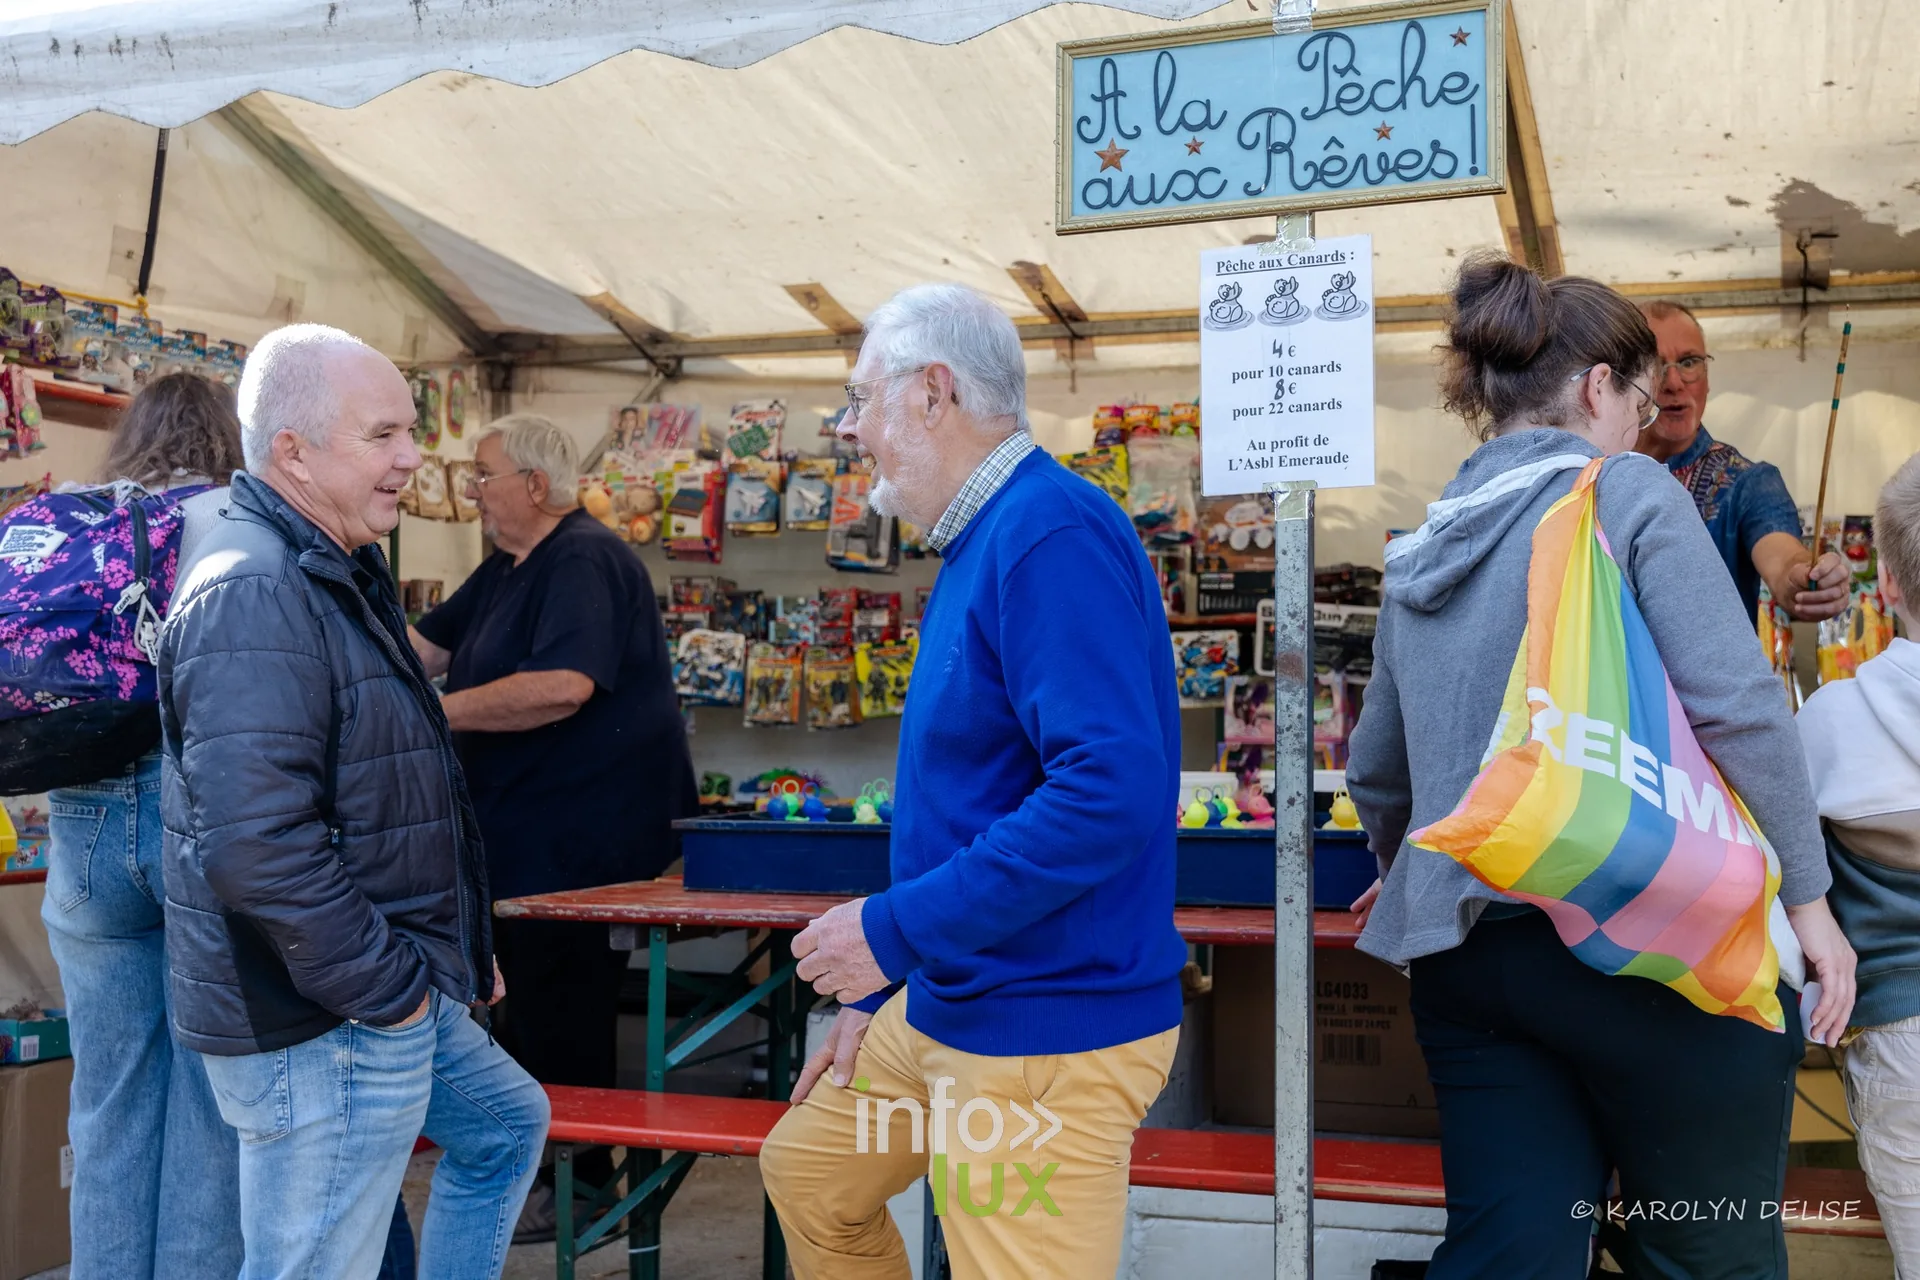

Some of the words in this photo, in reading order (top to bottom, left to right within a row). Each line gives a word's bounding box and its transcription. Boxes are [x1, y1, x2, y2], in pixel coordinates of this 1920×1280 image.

[1077, 58, 1141, 143] A
[1154, 51, 1228, 136] la
[1298, 20, 1480, 121] Pêche
[1082, 167, 1228, 210] aux
[1237, 103, 1479, 196] Rêves!
[1216, 260, 1255, 274] Pêche
[1258, 257, 1283, 269] aux
[1287, 250, 1346, 267] Canards
[1232, 368, 1264, 384] pour
[1269, 364, 1284, 377] 10
[1287, 360, 1342, 376] canards
[1232, 405, 1264, 421] pour
[1268, 402, 1284, 415] 22
[1288, 398, 1343, 413] canards
[1247, 439, 1266, 451] Au
[1270, 435, 1310, 454] profit
[1313, 434, 1329, 446] de
[1278, 451, 1349, 468] Emeraude
